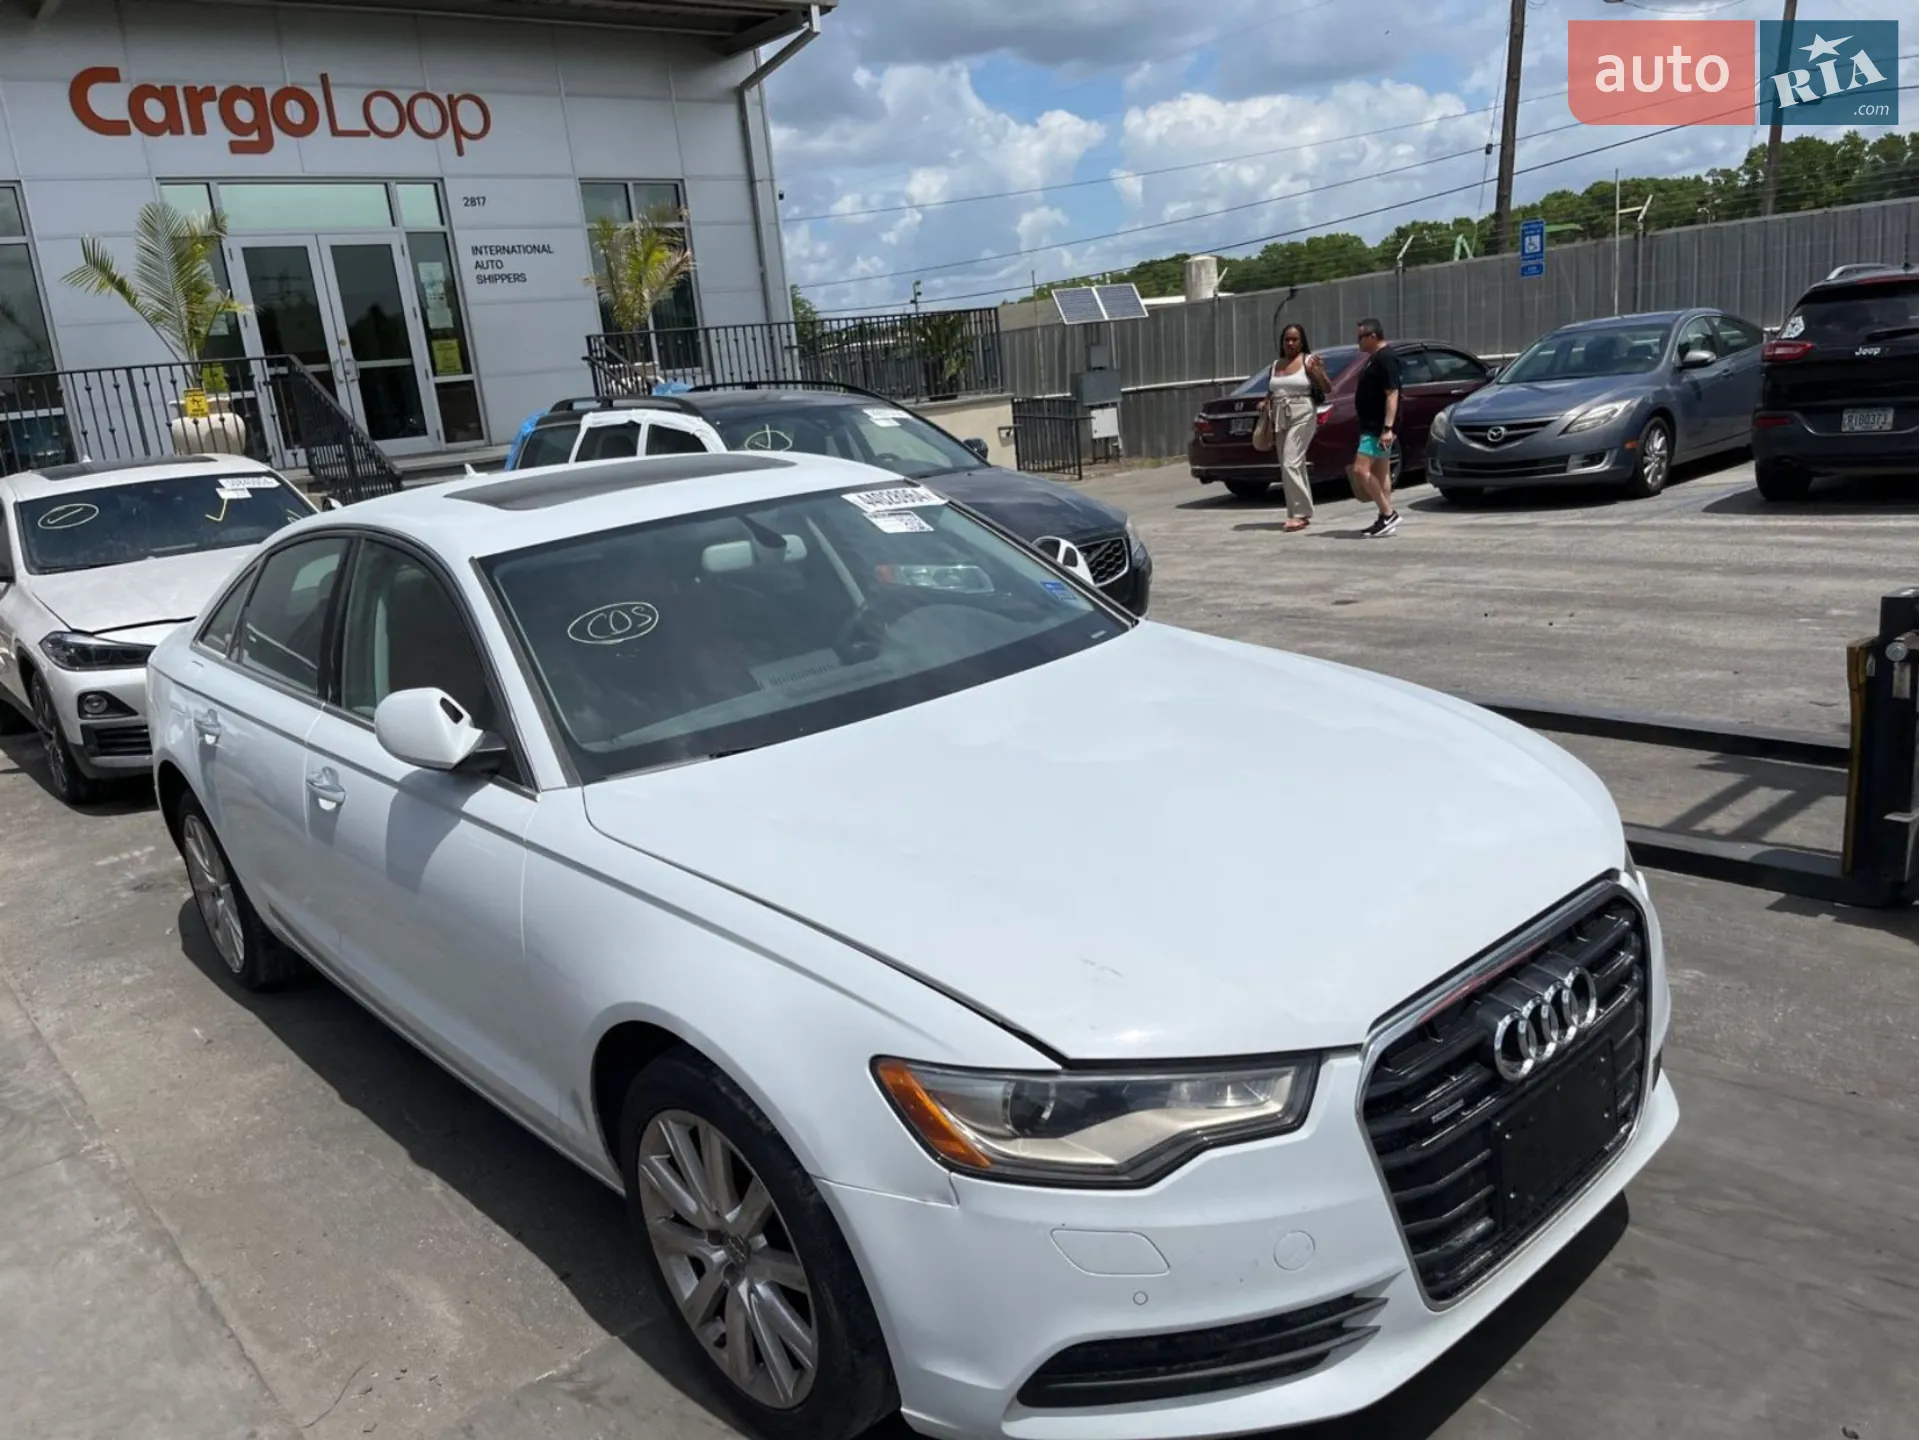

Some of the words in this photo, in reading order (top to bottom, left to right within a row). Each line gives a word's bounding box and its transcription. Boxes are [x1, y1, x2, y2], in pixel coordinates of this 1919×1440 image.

[68, 65, 492, 157] CargoLoop
[462, 196, 486, 208] 2817
[471, 244, 554, 256] INTERNATIONAL
[474, 259, 504, 270] AUTO
[476, 272, 527, 284] SHIPPERS
[1854, 347, 1881, 356] Jeep
